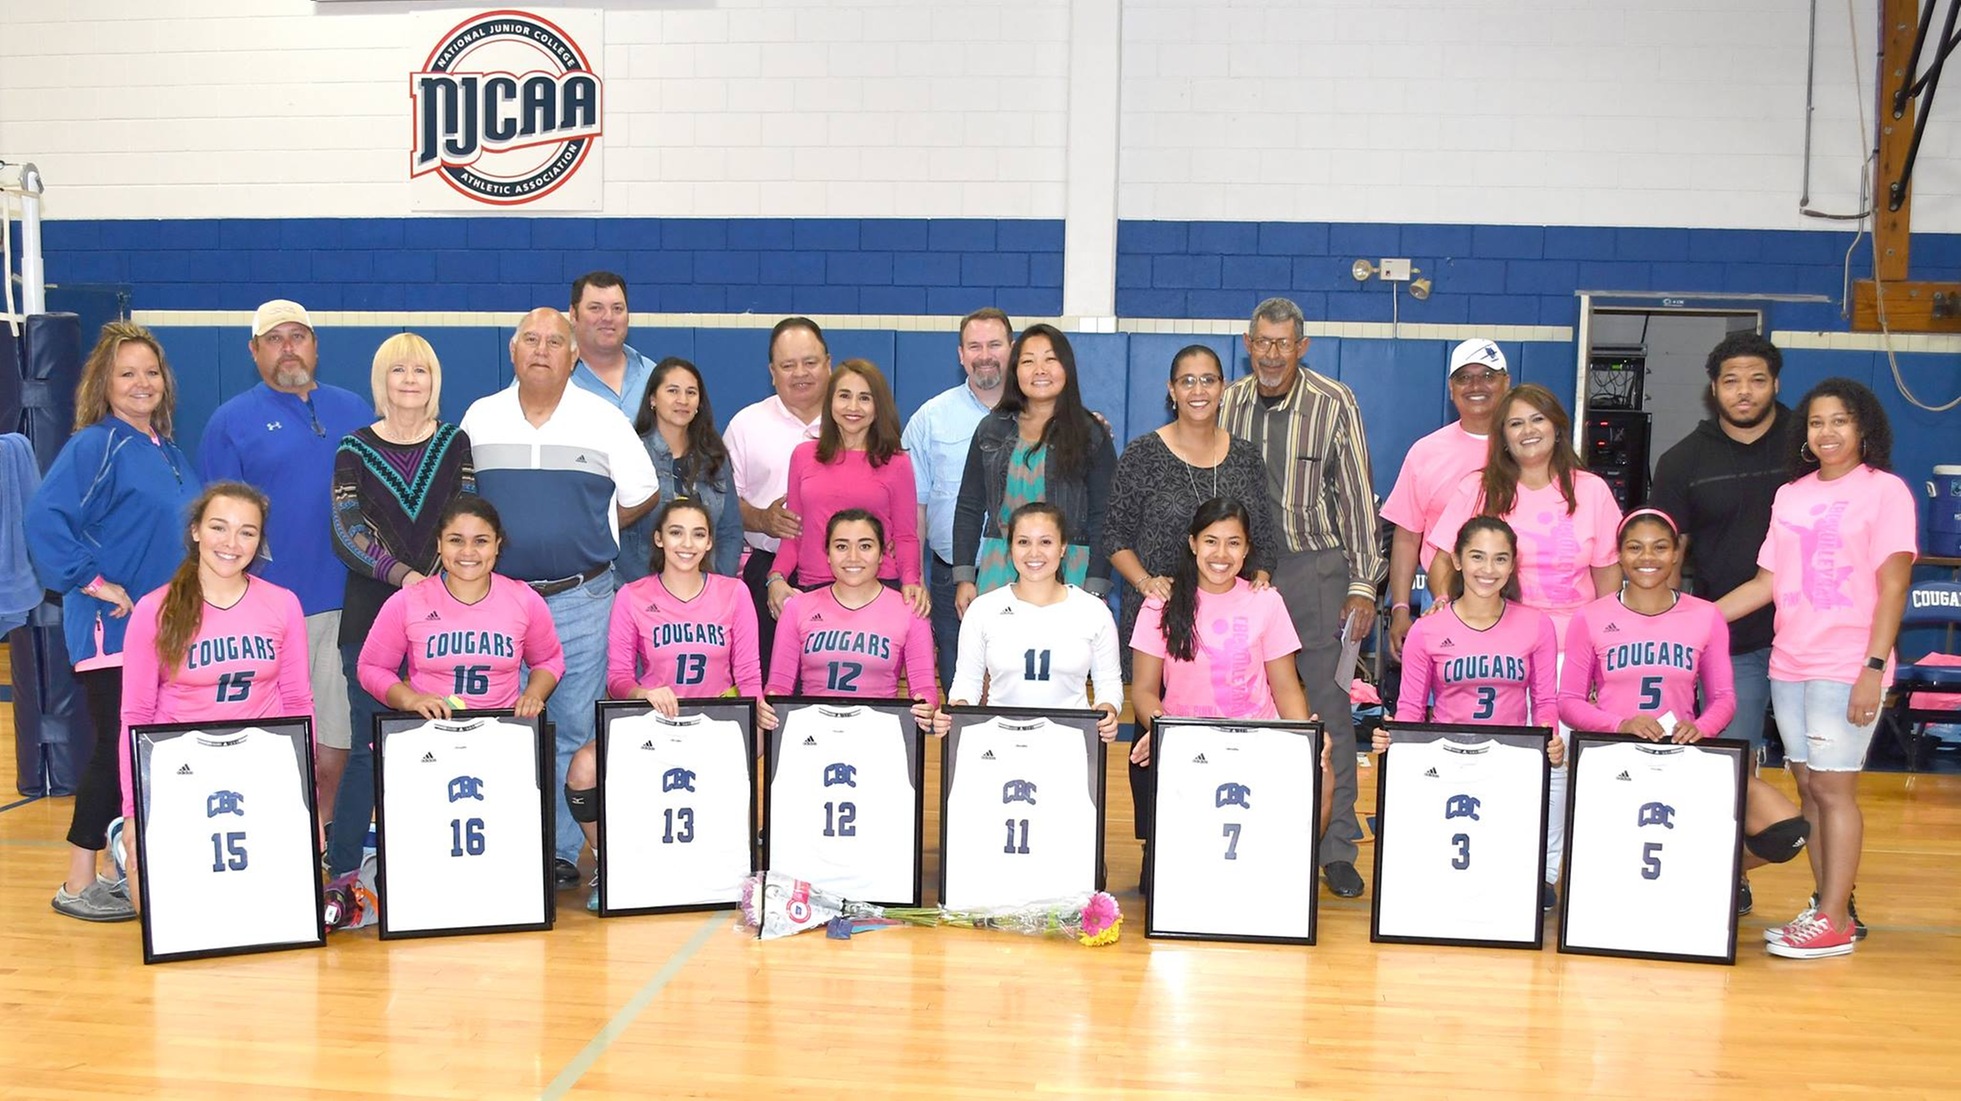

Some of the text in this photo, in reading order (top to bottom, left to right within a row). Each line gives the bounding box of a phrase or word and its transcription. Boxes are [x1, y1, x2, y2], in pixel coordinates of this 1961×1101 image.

[438, 24, 575, 68] NATIONAL JUNIOR COLLEGE
[419, 76, 596, 164] NJCAA
[461, 144, 578, 194] ATHLETIC ASSOCIATION
[1911, 590, 1961, 608] COUGA
[425, 631, 514, 659] COUGARS
[653, 623, 726, 649] COUGARS
[804, 630, 890, 660] COUGARS
[187, 635, 275, 670] COUGARS
[1024, 648, 1051, 681] 11
[1606, 641, 1694, 671] COUGARS
[453, 665, 492, 695] 16
[675, 653, 707, 685] 13
[826, 661, 863, 692] 12
[1444, 655, 1525, 683] COUGARS
[216, 670, 256, 703] 15
[1638, 676, 1663, 710] 5
[1472, 686, 1497, 720] 3
[448, 776, 484, 803] CBC
[662, 768, 696, 793] CBC
[823, 762, 857, 788] CBC
[207, 790, 244, 818] CBC
[1002, 779, 1037, 805] CBC
[1215, 782, 1251, 809] CBC
[1445, 794, 1481, 821] CBC
[662, 808, 694, 843] 13
[823, 802, 856, 837] 12
[1637, 802, 1675, 829] CBC
[211, 831, 248, 872] 15
[450, 818, 485, 857] 16
[1004, 818, 1030, 854] 11
[1223, 823, 1242, 860] 7
[1451, 833, 1470, 870] 3
[1641, 842, 1663, 880] 5
